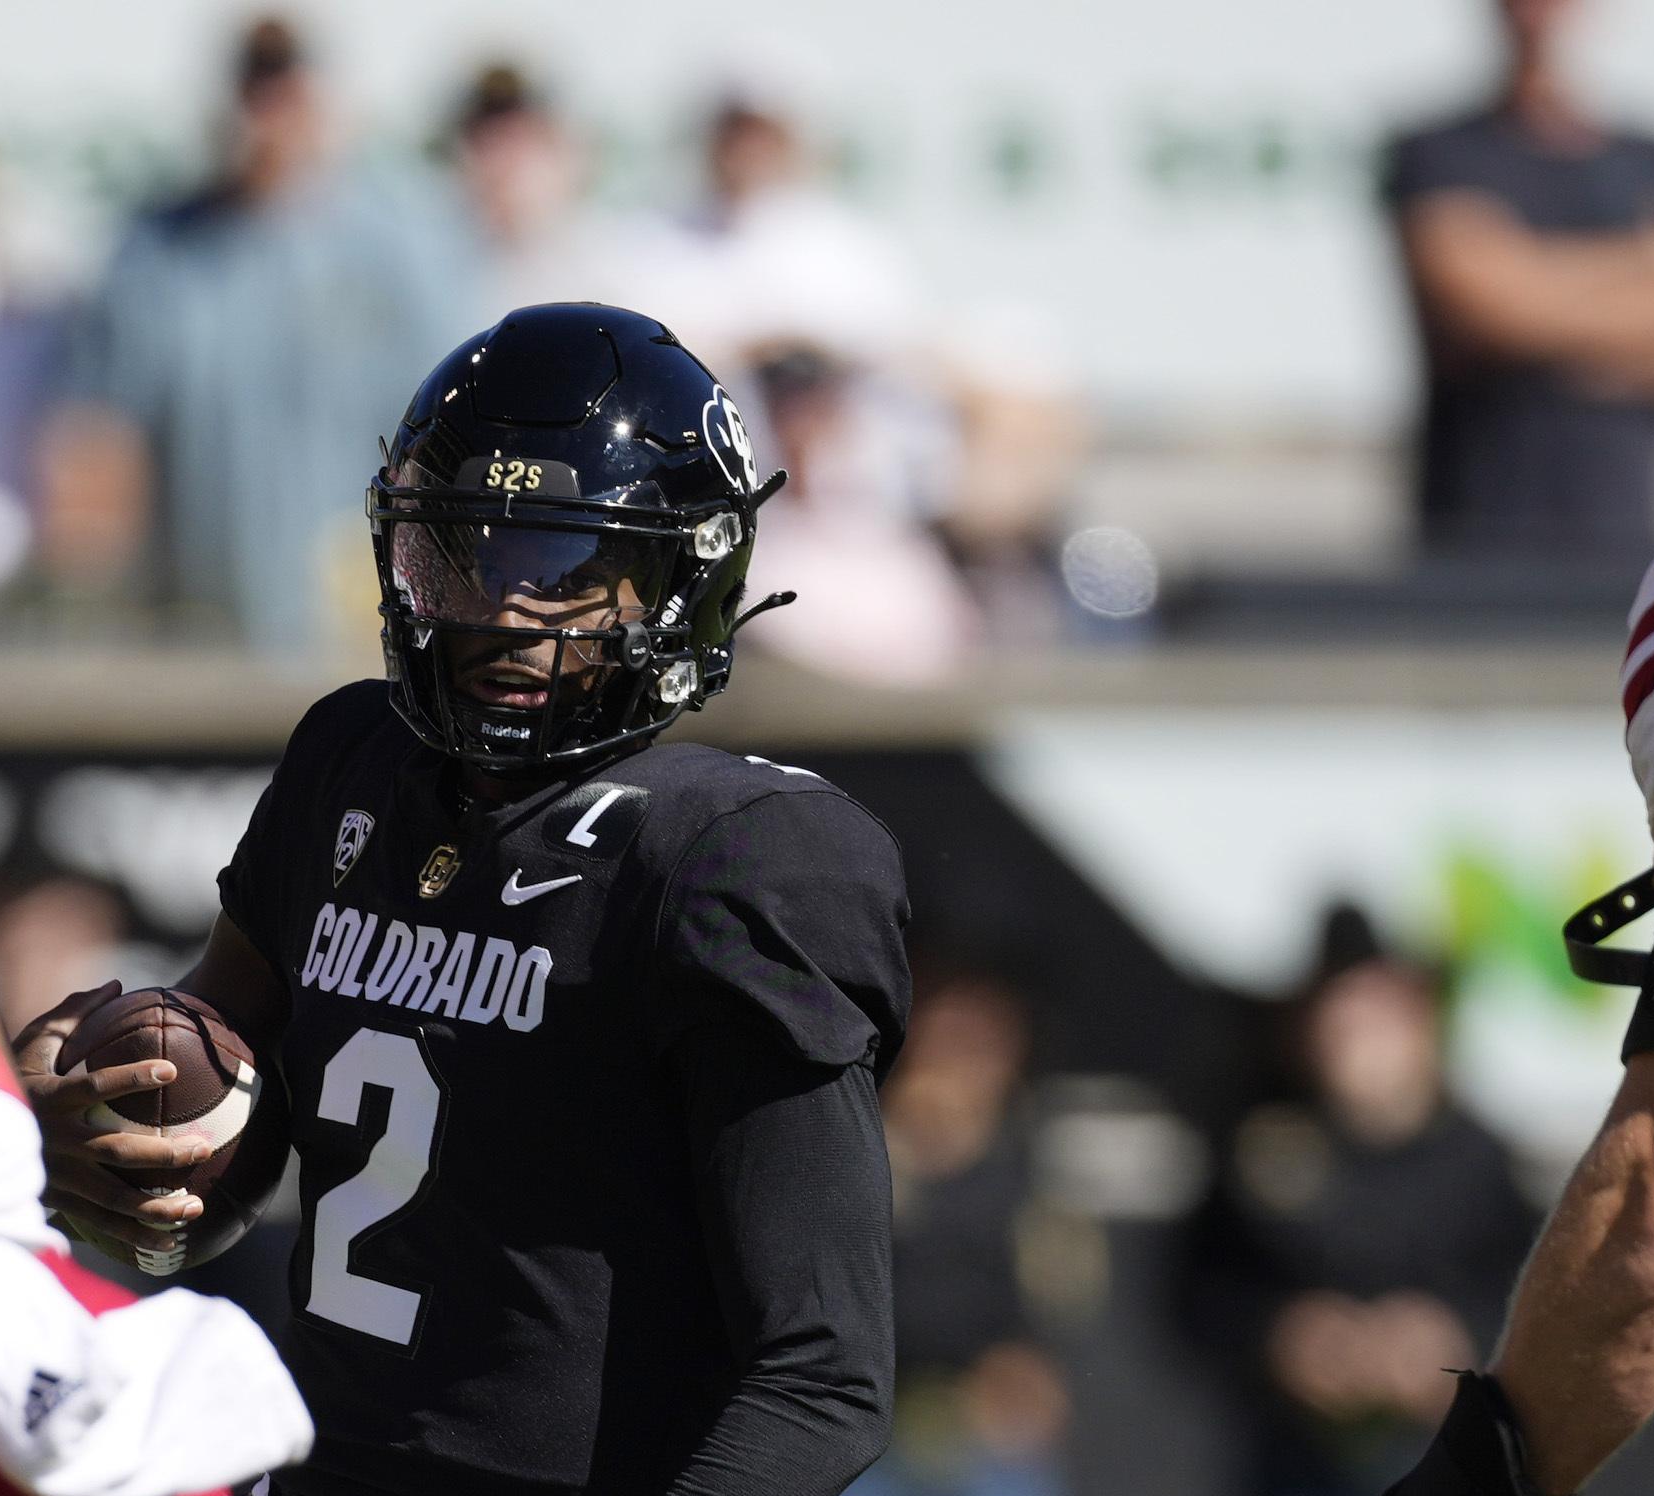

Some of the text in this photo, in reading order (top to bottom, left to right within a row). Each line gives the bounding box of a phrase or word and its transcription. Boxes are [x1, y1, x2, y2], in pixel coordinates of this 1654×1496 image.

[481, 722, 531, 740] Riddell
[301, 903, 553, 1032] COLORADO
[305, 1027, 440, 1345] 2
